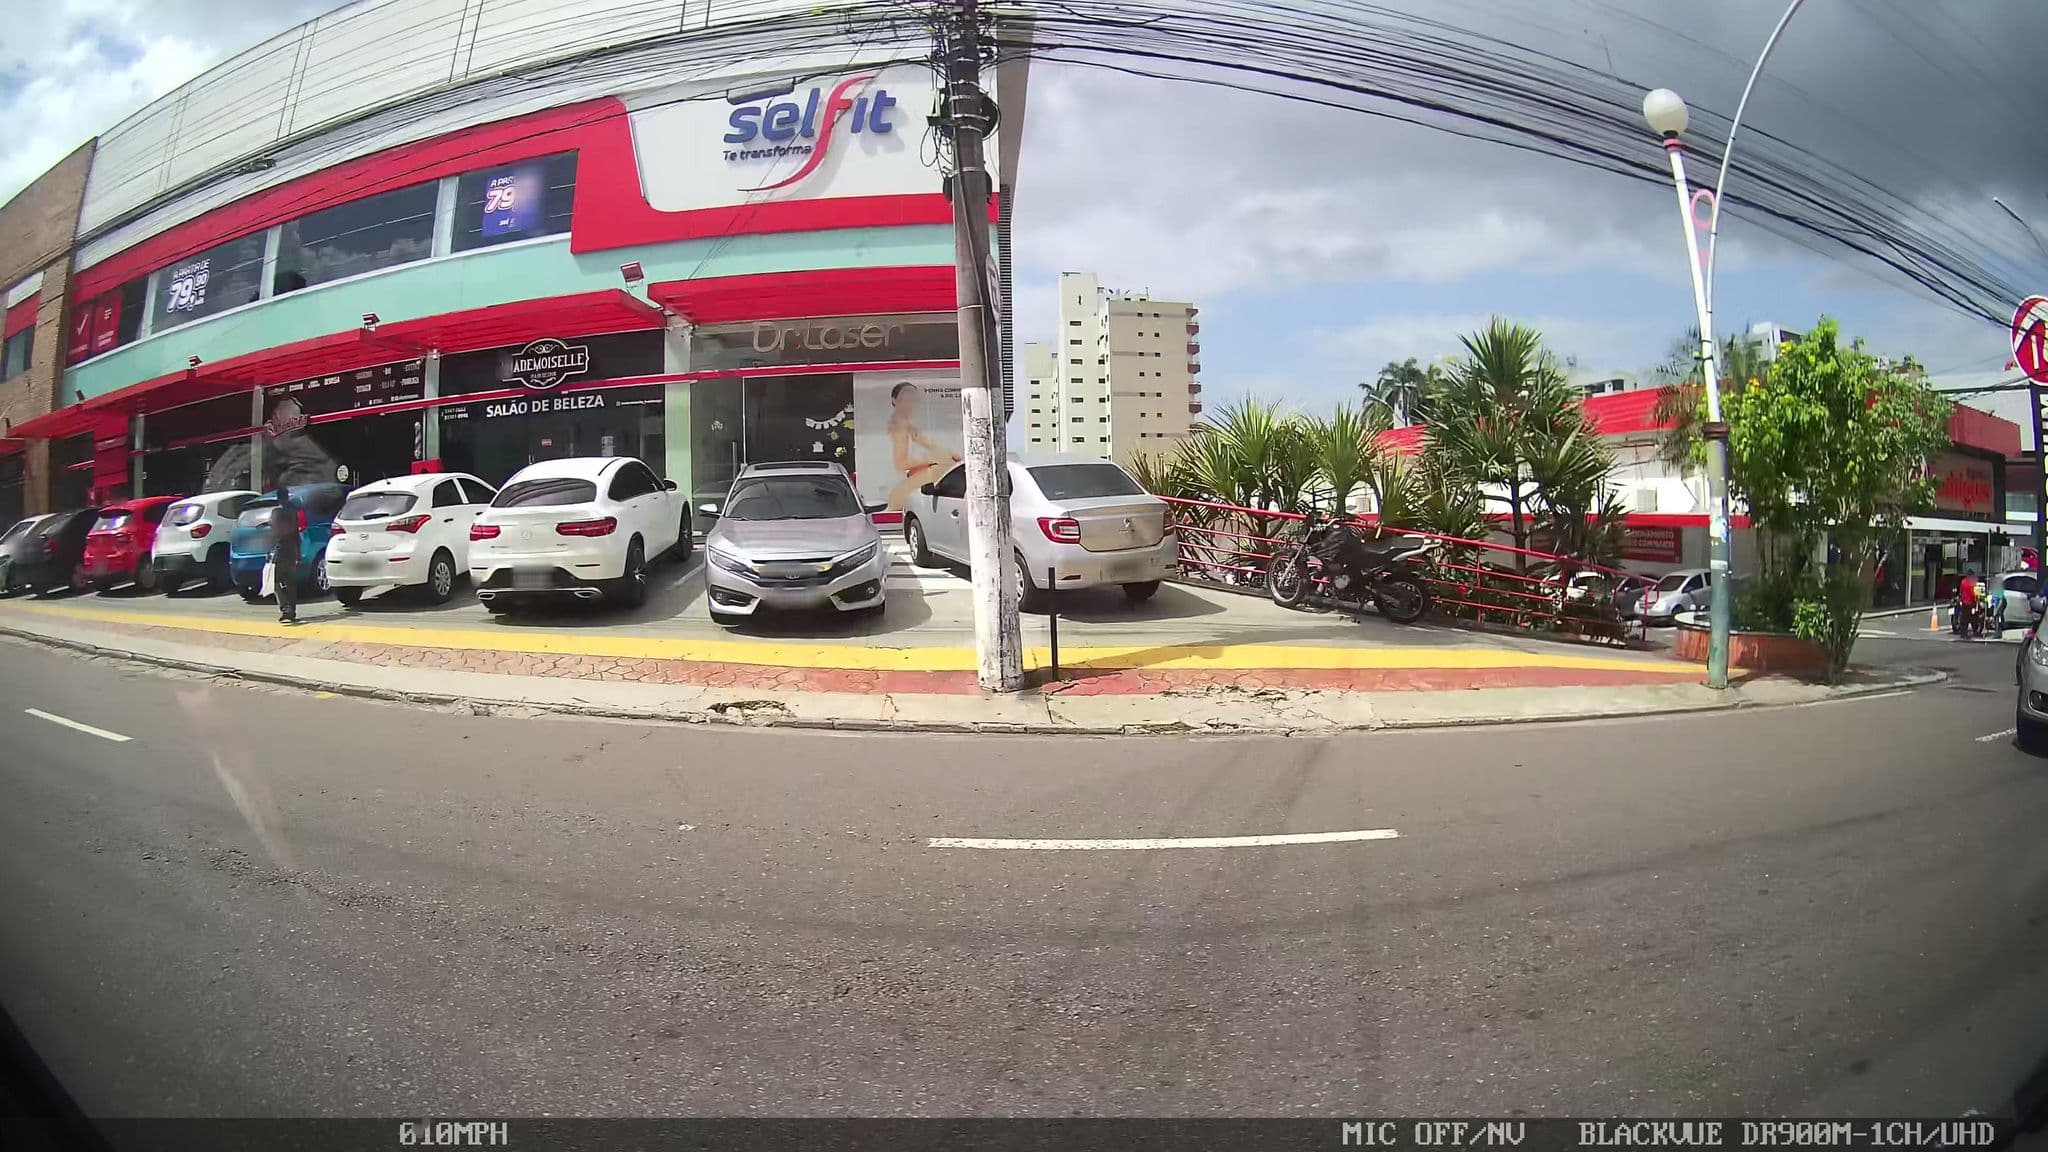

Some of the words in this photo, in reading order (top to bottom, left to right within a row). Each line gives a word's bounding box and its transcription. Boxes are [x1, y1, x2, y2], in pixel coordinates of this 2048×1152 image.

[724, 150, 738, 161] Te
[740, 144, 812, 160] transforma
[503, 352, 585, 374] ADEMOISELLE
[486, 400, 528, 418] SALÃO
[531, 399, 550, 413] DE
[553, 394, 605, 411] BELEZA
